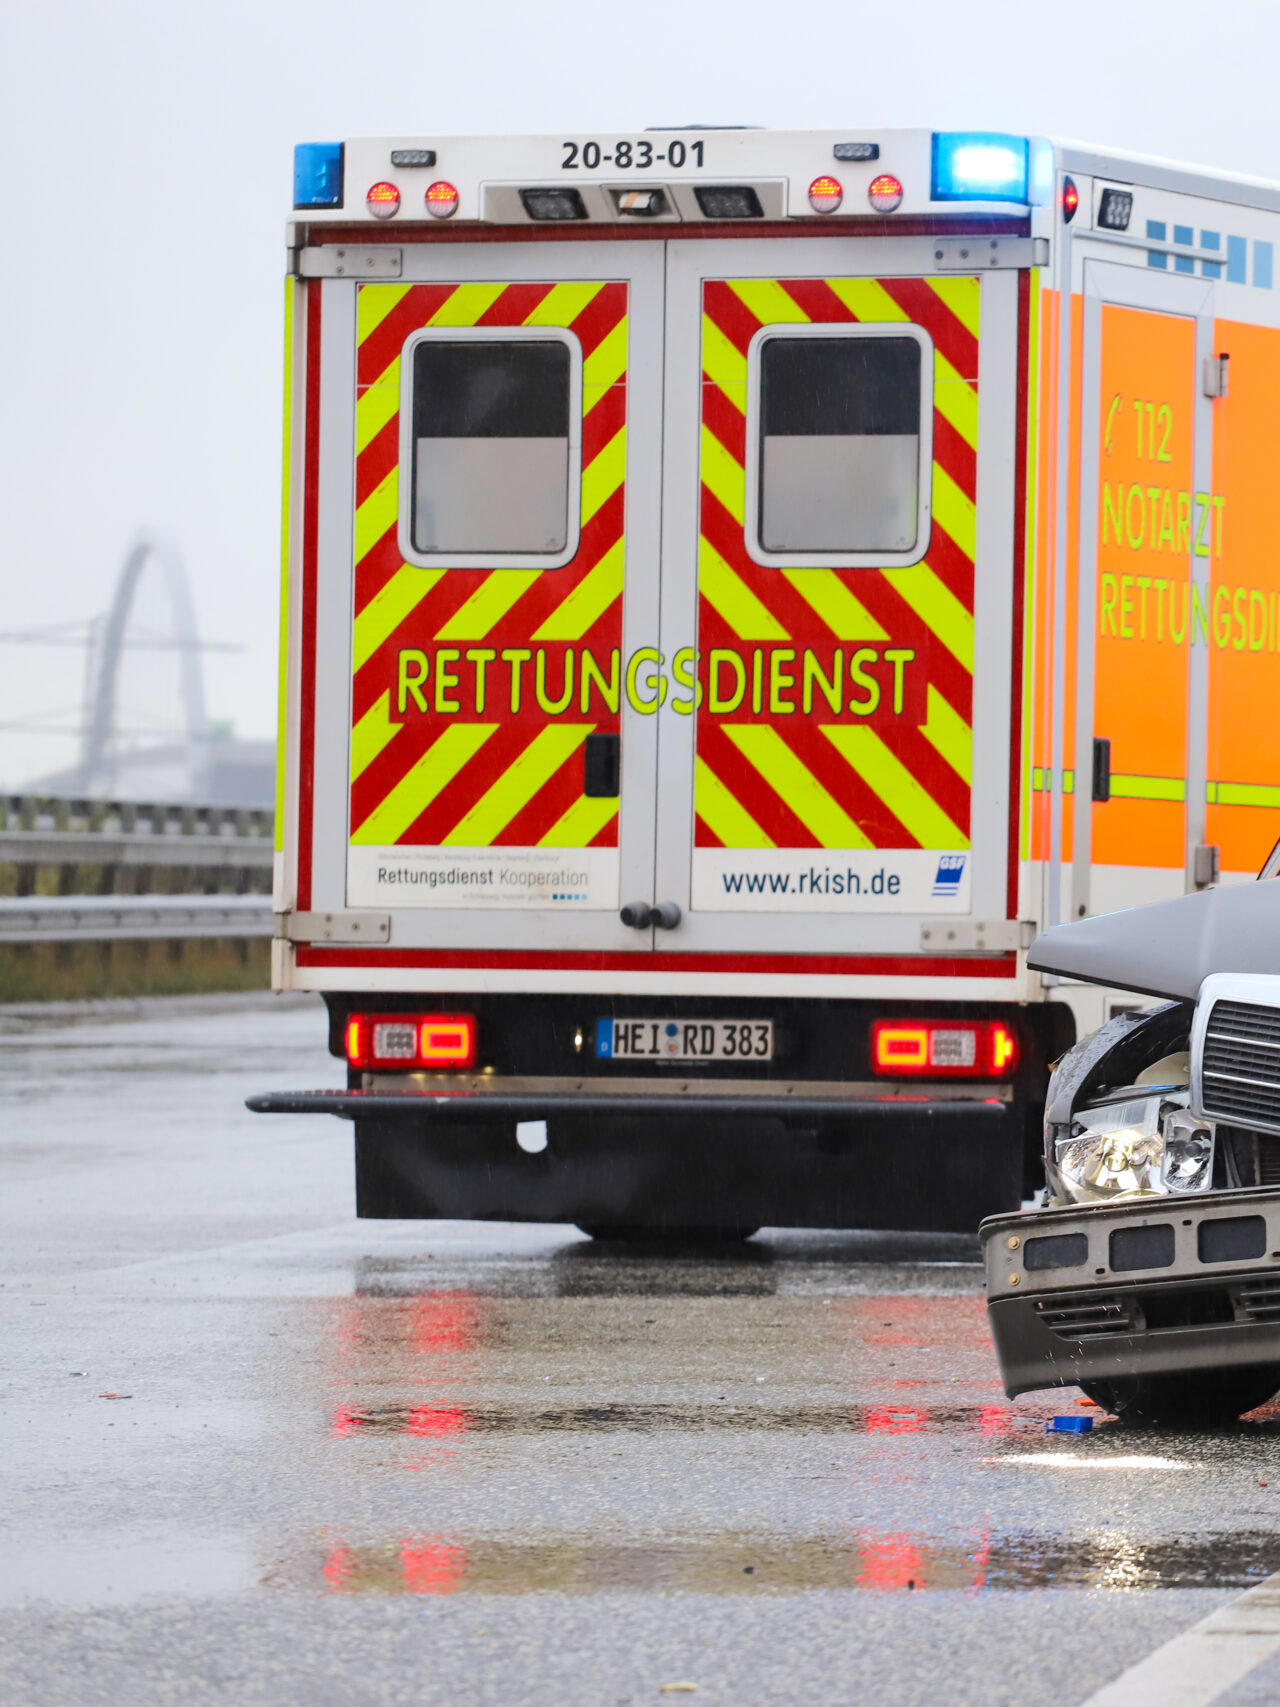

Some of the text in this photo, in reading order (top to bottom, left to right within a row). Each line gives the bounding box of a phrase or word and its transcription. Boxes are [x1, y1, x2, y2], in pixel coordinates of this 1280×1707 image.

[561, 140, 704, 169] 20-83-01
[1134, 399, 1172, 463] 112
[1103, 481, 1226, 558] NOTARZT
[397, 646, 916, 715] RETTUNGSDIENST
[377, 867, 589, 888] Rettungsdienst Kooperation
[940, 856, 966, 870] GSF
[722, 867, 901, 895] www.rkish.de
[614, 1023, 770, 1056] HEI RD 383
